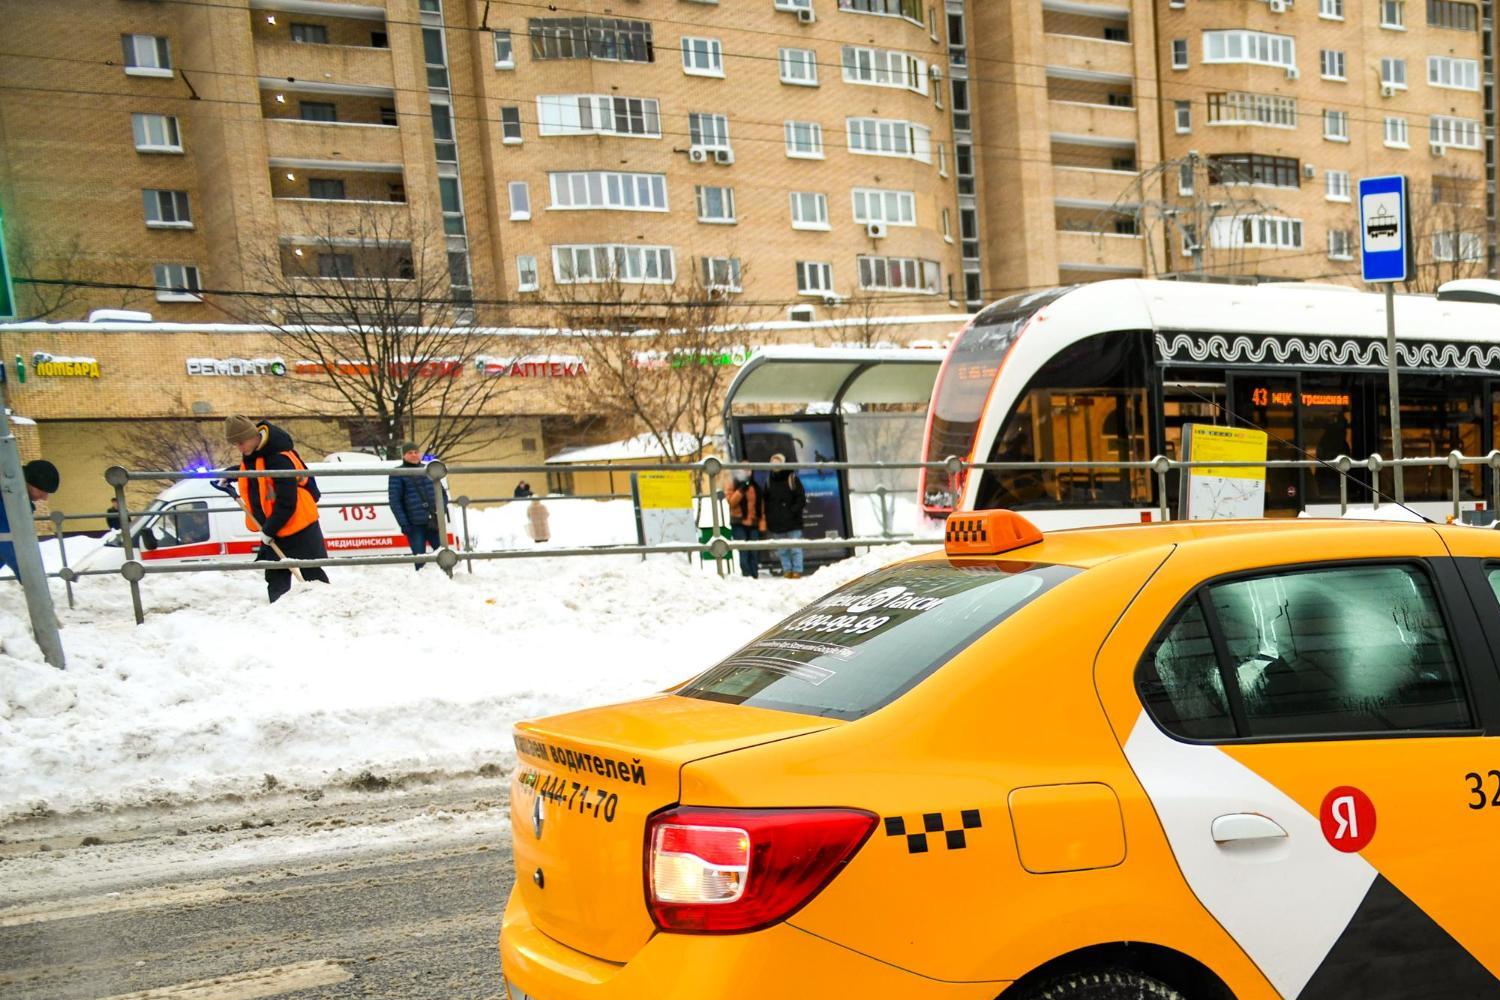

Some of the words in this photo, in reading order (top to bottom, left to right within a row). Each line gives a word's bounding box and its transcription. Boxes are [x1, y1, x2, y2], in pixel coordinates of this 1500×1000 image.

[510, 361, 586, 378] АПТЕКА
[1252, 388, 1268, 406] 43
[1301, 394, 1349, 406] грешская
[338, 504, 377, 521] 103
[327, 537, 393, 548] МЕДИЦИНСКАЯ
[550, 744, 646, 786] водителей
[541, 776, 618, 823] 444-71-70
[1331, 796, 1358, 839] Я
